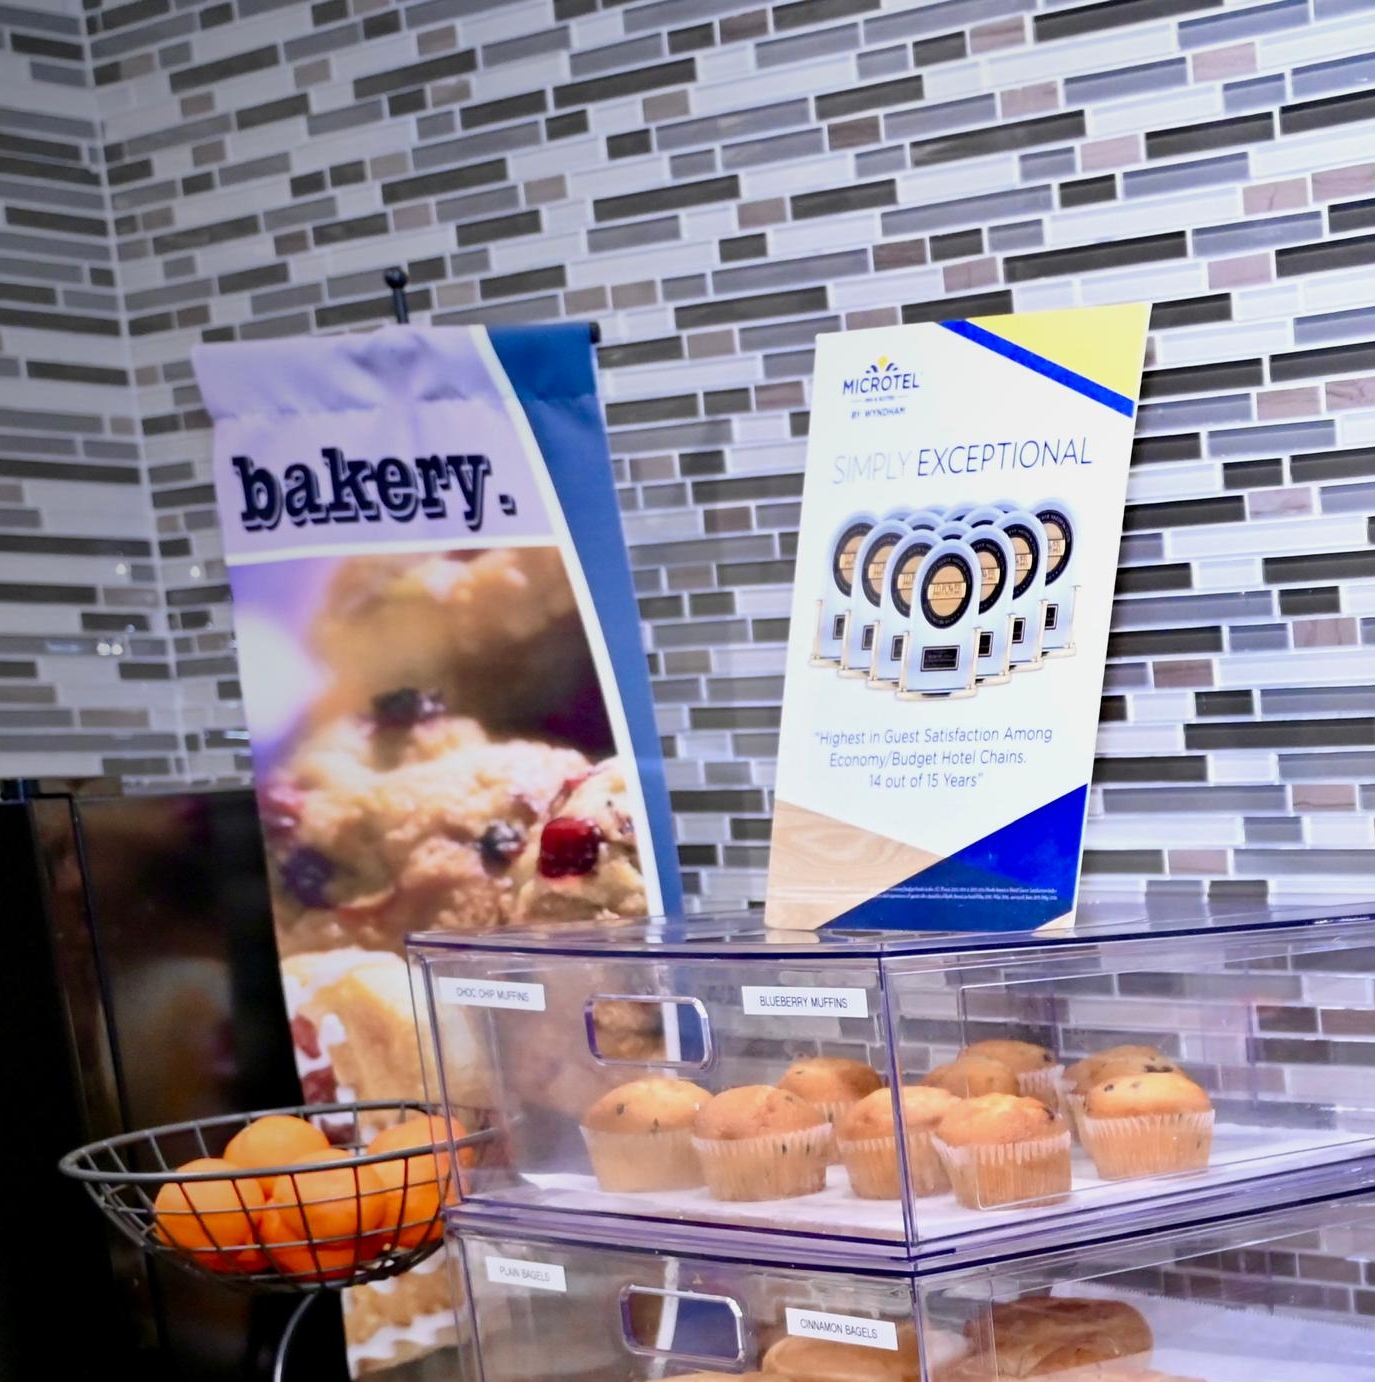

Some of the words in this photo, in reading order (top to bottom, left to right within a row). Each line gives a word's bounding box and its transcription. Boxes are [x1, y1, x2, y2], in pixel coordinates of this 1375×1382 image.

[842, 373, 920, 395] MICROTEL
[864, 406, 906, 417] WYNDHAM
[833, 450, 912, 485] SIMPLY
[917, 437, 1093, 477] EXCEPTIONAL
[231, 447, 517, 532] bakery.
[884, 728, 920, 744] Guest
[924, 727, 999, 744] Satisfaction
[1003, 726, 1053, 743] Among
[829, 750, 938, 768] Economy/Budget
[942, 749, 976, 765] Hotel
[869, 774, 881, 788] 14
[885, 775, 907, 788] out
[909, 772, 924, 788] of
[927, 772, 939, 788] 15
[456, 987, 477, 999] CHOC
[478, 988, 496, 1000] CHIP
[496, 989, 530, 1002] MUFFINS
[759, 995, 808, 1007] BLUEBERRY
[810, 996, 848, 1009] MUFFINS
[500, 1265, 520, 1278] PLAIN
[521, 1268, 550, 1282] BAGELS
[800, 1318, 843, 1334] CINNAMON
[845, 1324, 878, 1340] BAGELS
